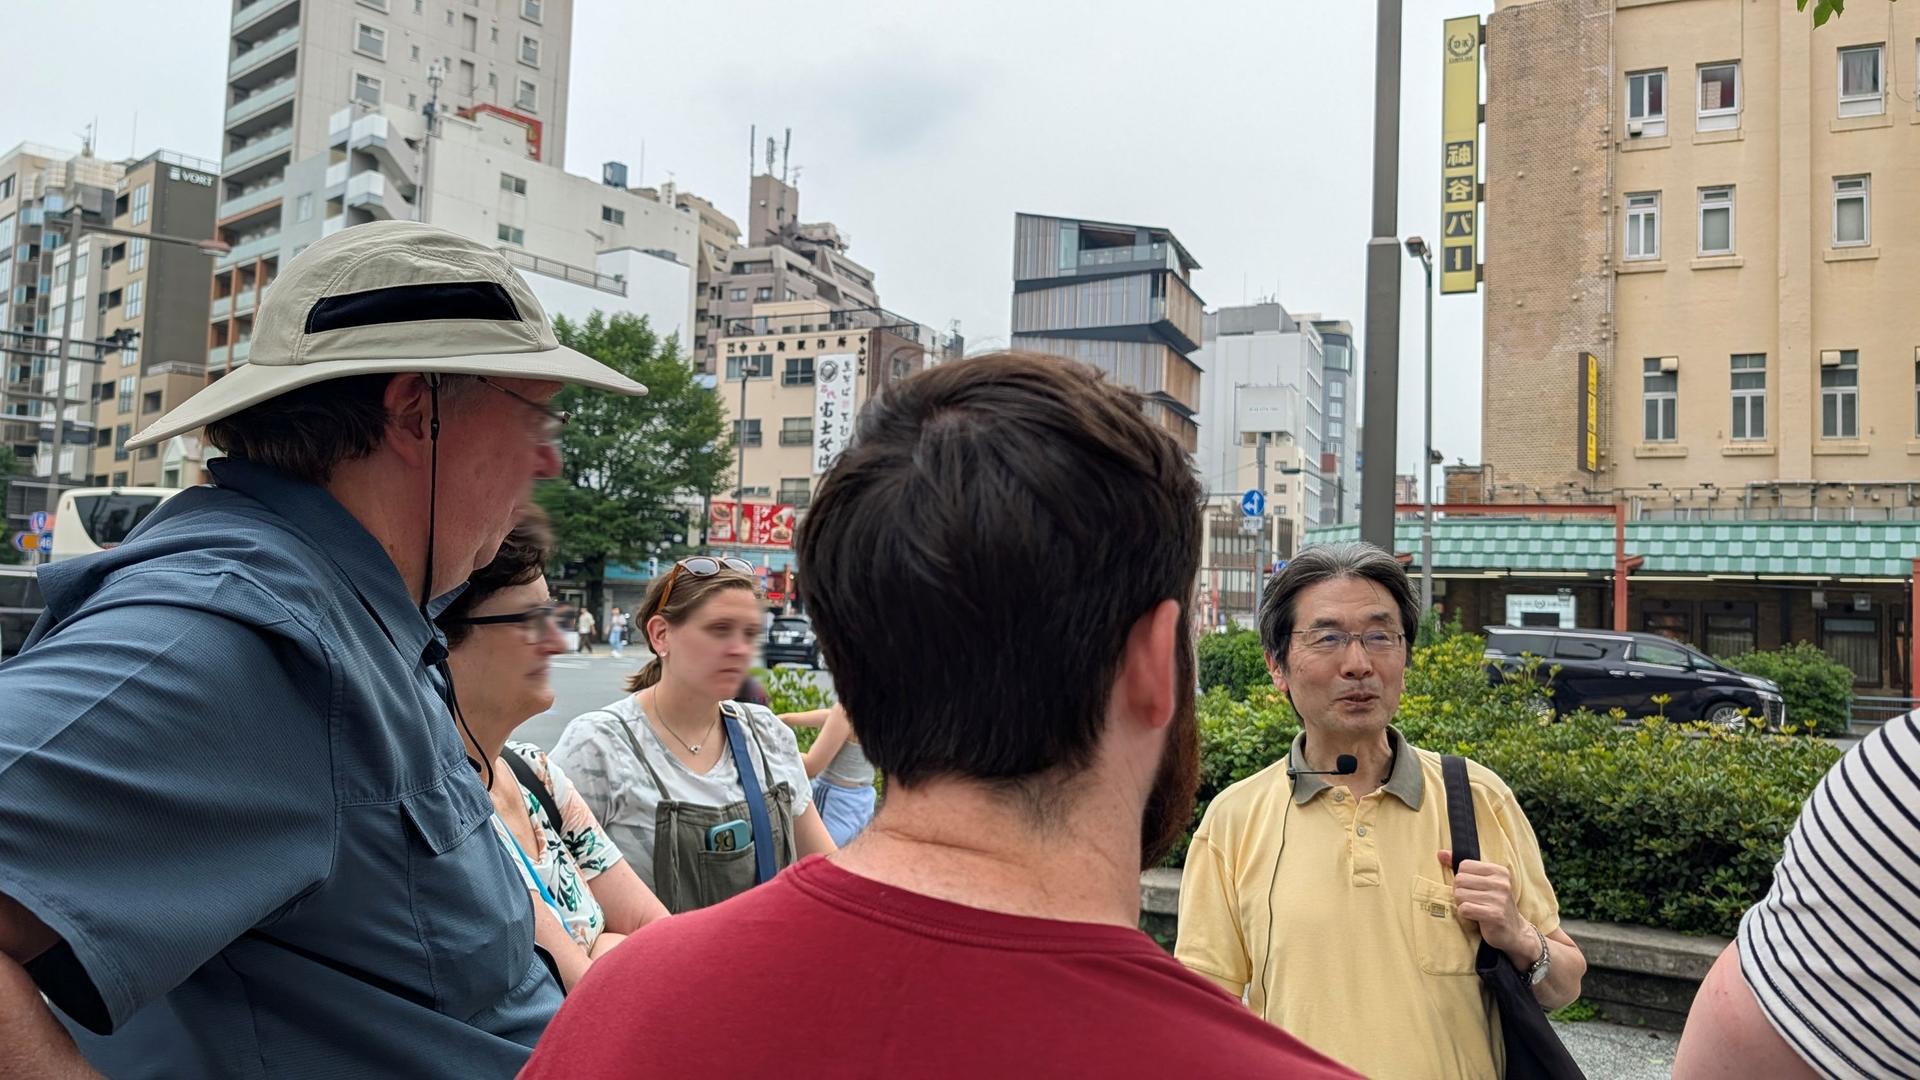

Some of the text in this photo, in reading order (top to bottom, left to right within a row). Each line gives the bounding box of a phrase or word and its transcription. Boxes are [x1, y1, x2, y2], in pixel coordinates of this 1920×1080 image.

[182, 170, 214, 187] VORT
[1446, 143, 1472, 270] 神谷バー
